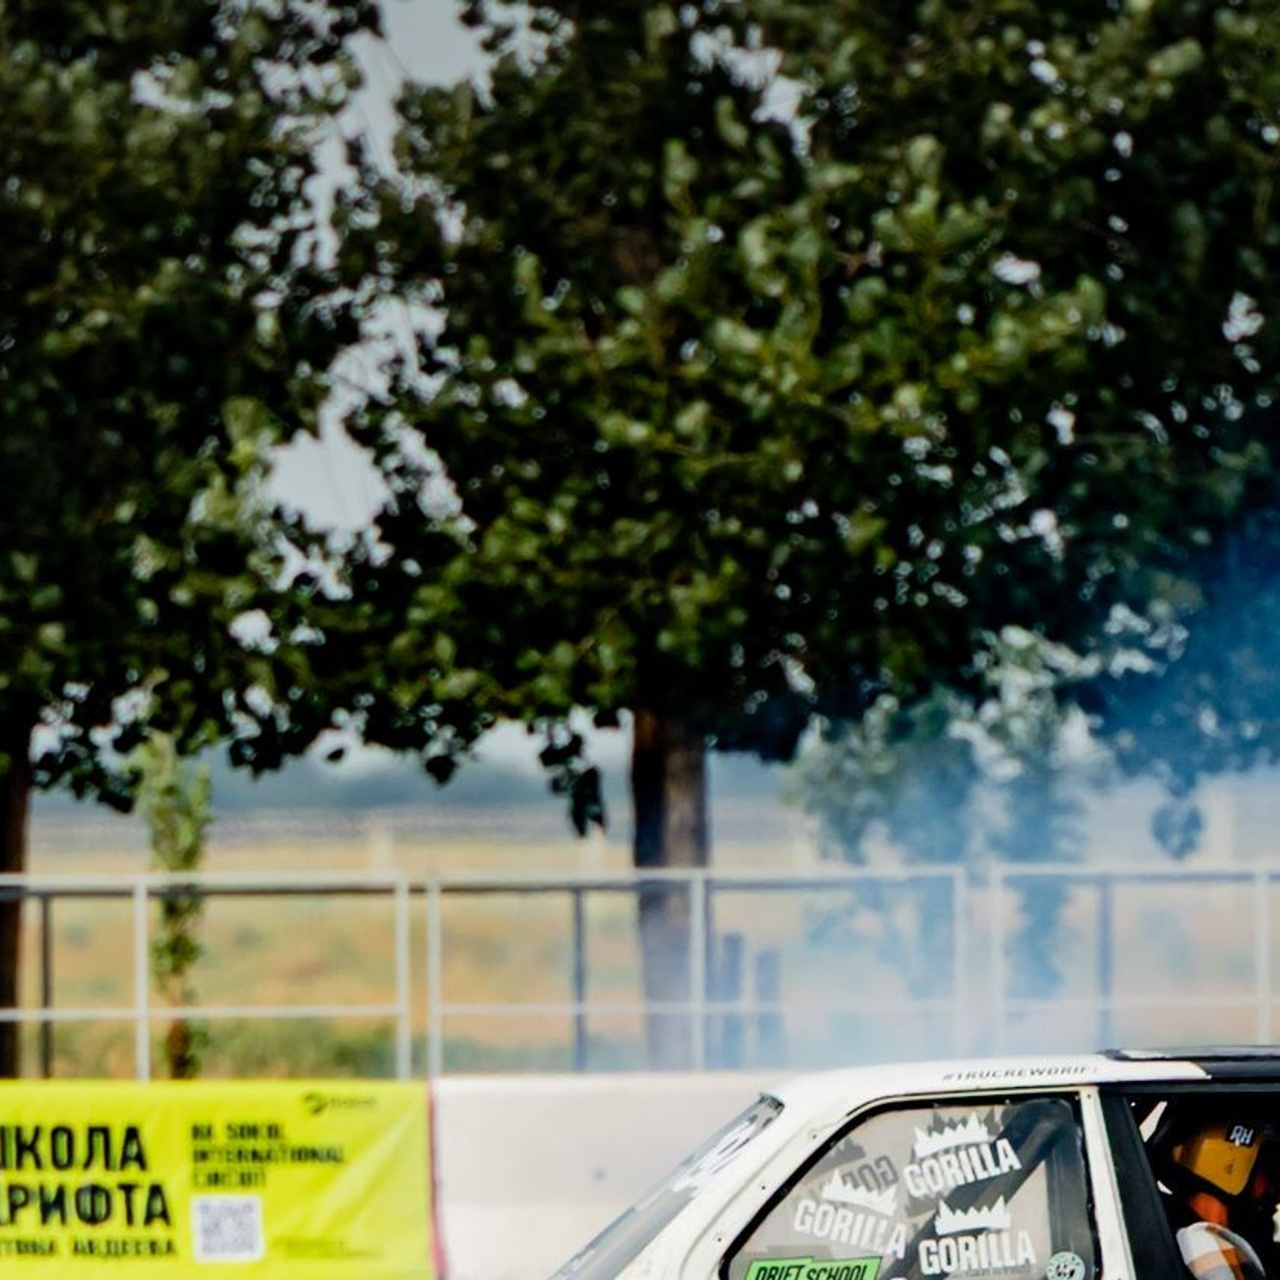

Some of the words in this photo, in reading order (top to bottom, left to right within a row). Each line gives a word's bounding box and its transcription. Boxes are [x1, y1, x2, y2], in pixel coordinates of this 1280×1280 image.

[903, 1138, 1023, 1198] GORILLA
[0, 1183, 171, 1226] РИФТА
[794, 1199, 908, 1259] GORILLA
[919, 1230, 1036, 1275] GORILLA
